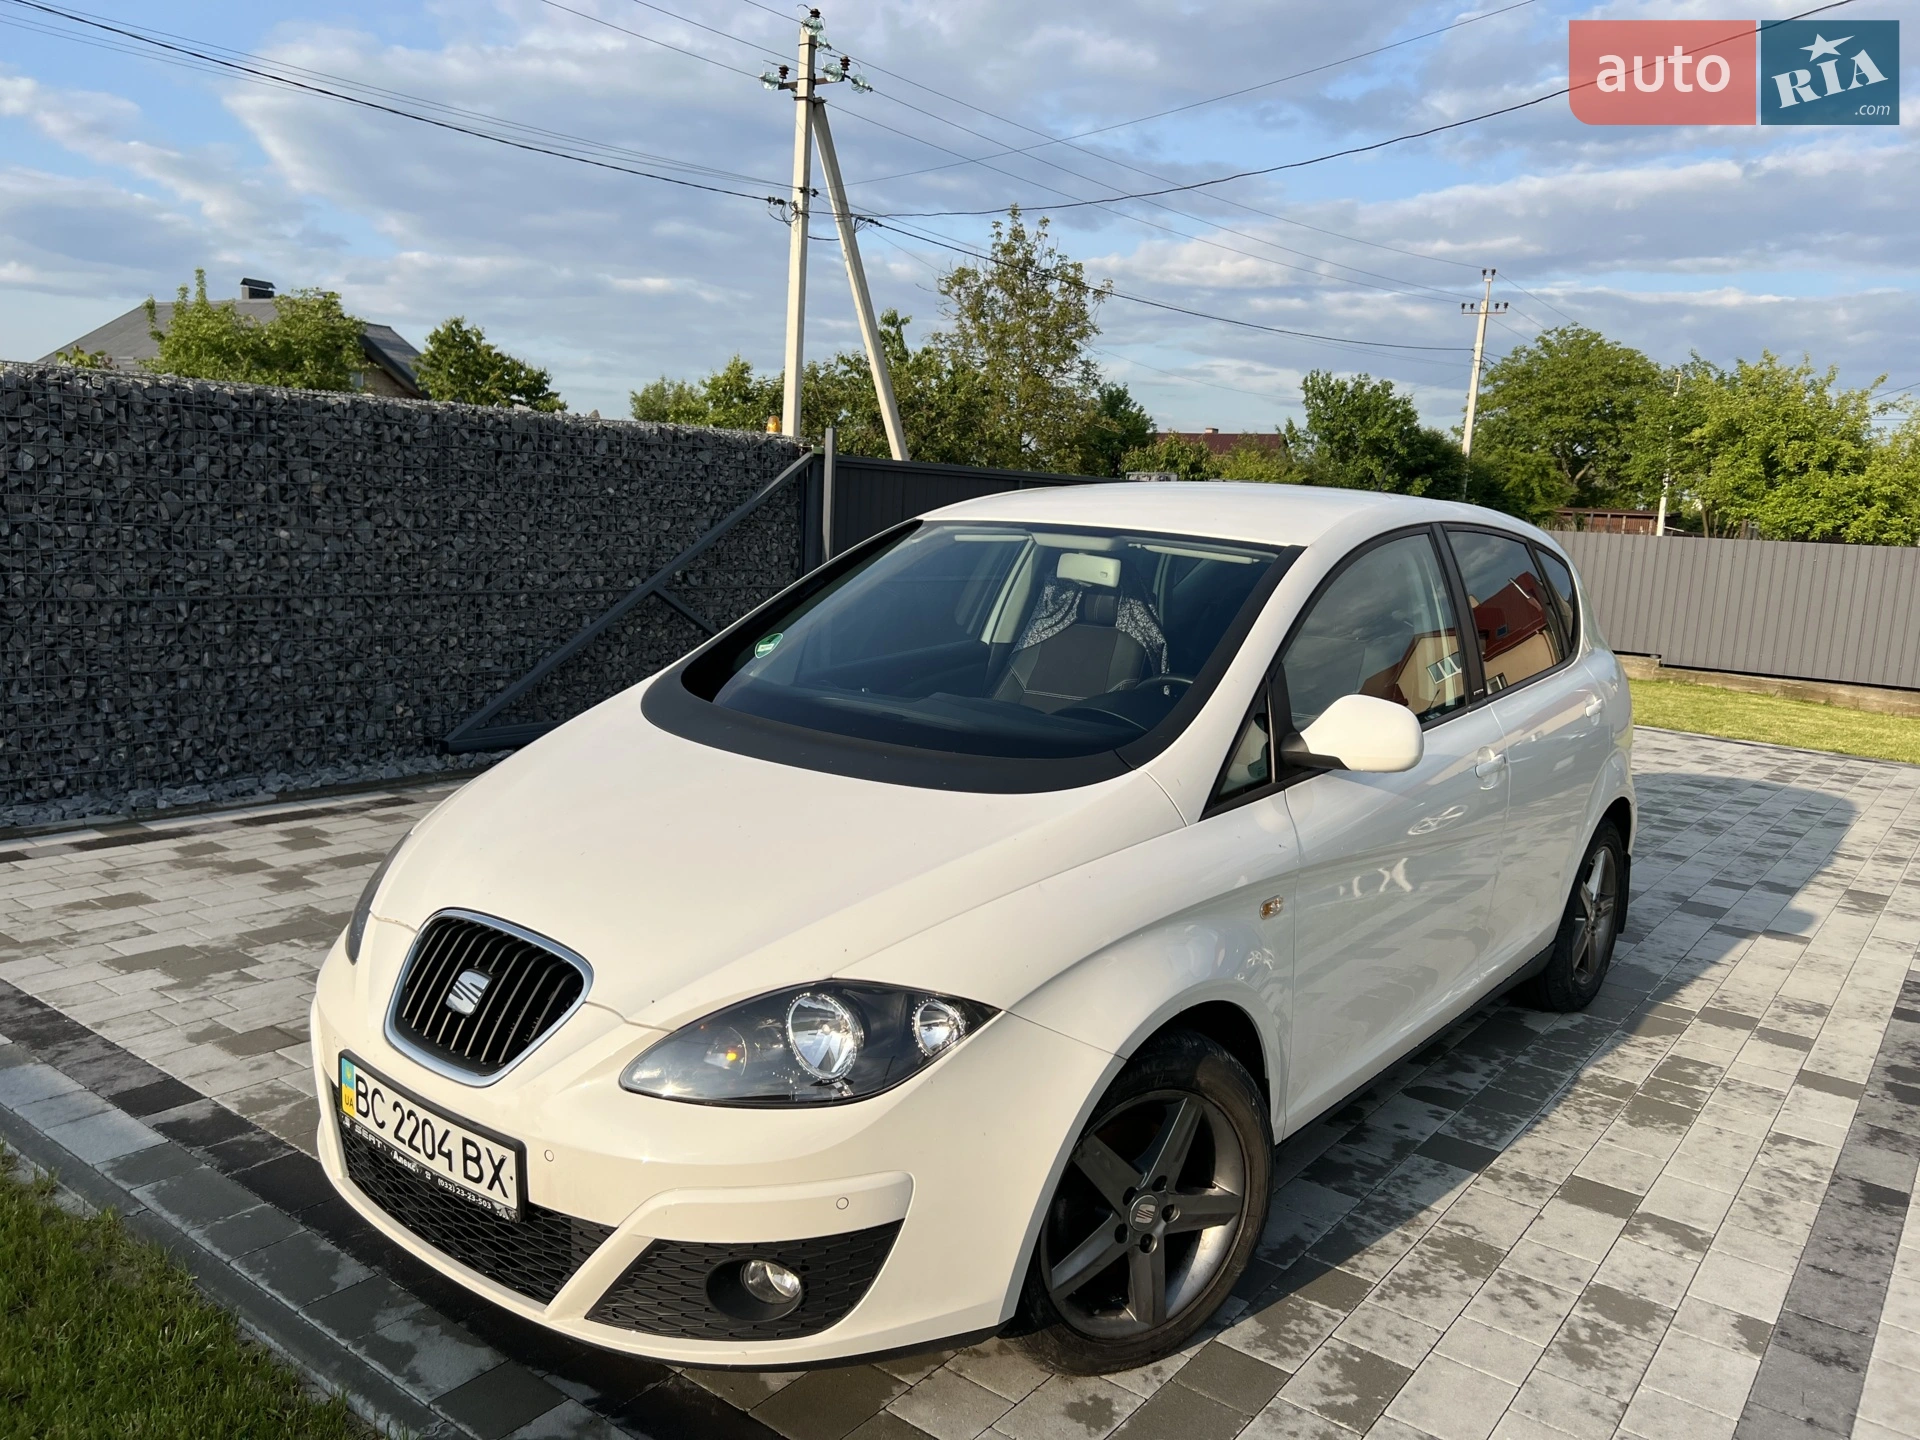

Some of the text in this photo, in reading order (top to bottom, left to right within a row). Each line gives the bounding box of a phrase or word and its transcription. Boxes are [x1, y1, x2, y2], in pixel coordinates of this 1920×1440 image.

[344, 1093, 354, 1108] UA
[355, 1073, 509, 1199] BC 2204 BX
